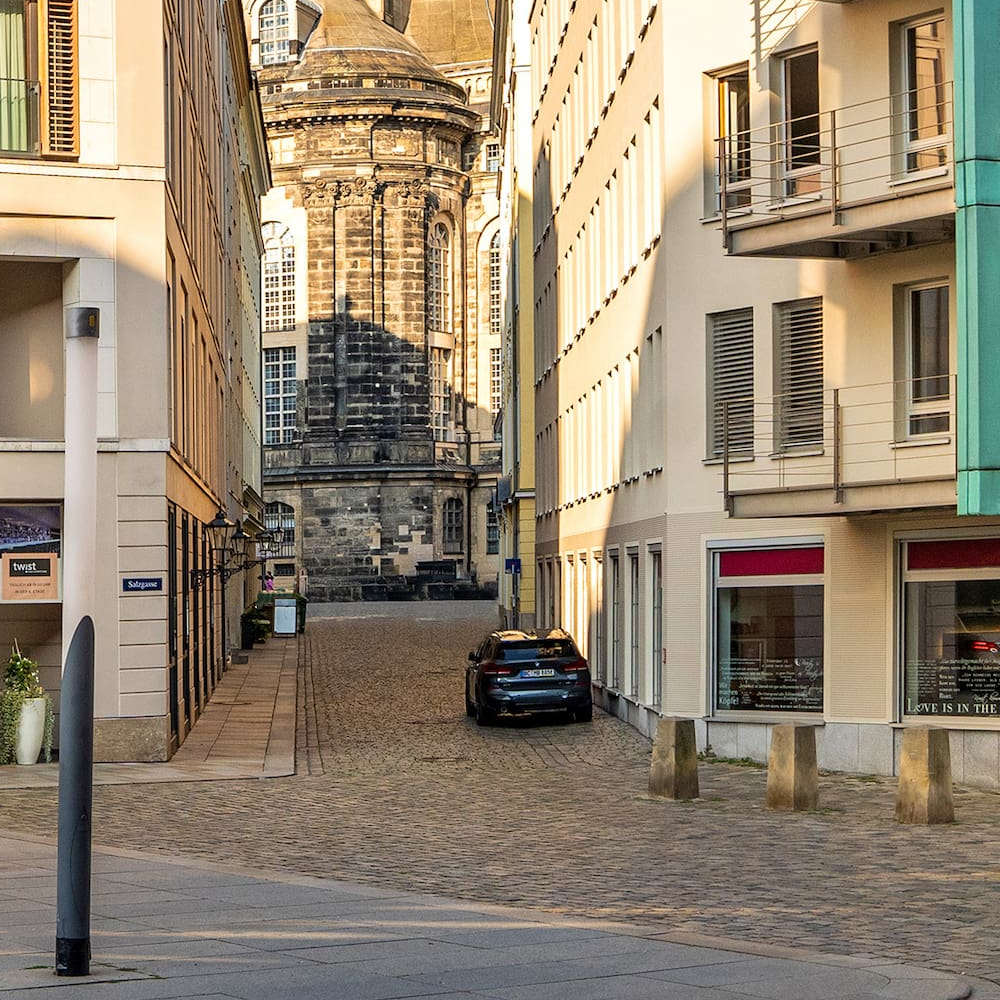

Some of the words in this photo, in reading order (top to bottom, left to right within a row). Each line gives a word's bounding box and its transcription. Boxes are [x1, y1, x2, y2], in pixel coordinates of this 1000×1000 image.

[13, 562, 37, 571] twist
[127, 580, 158, 590] Salzgasse
[942, 703, 953, 713] IS
[957, 703, 970, 713] IN
[974, 703, 997, 714] THE
